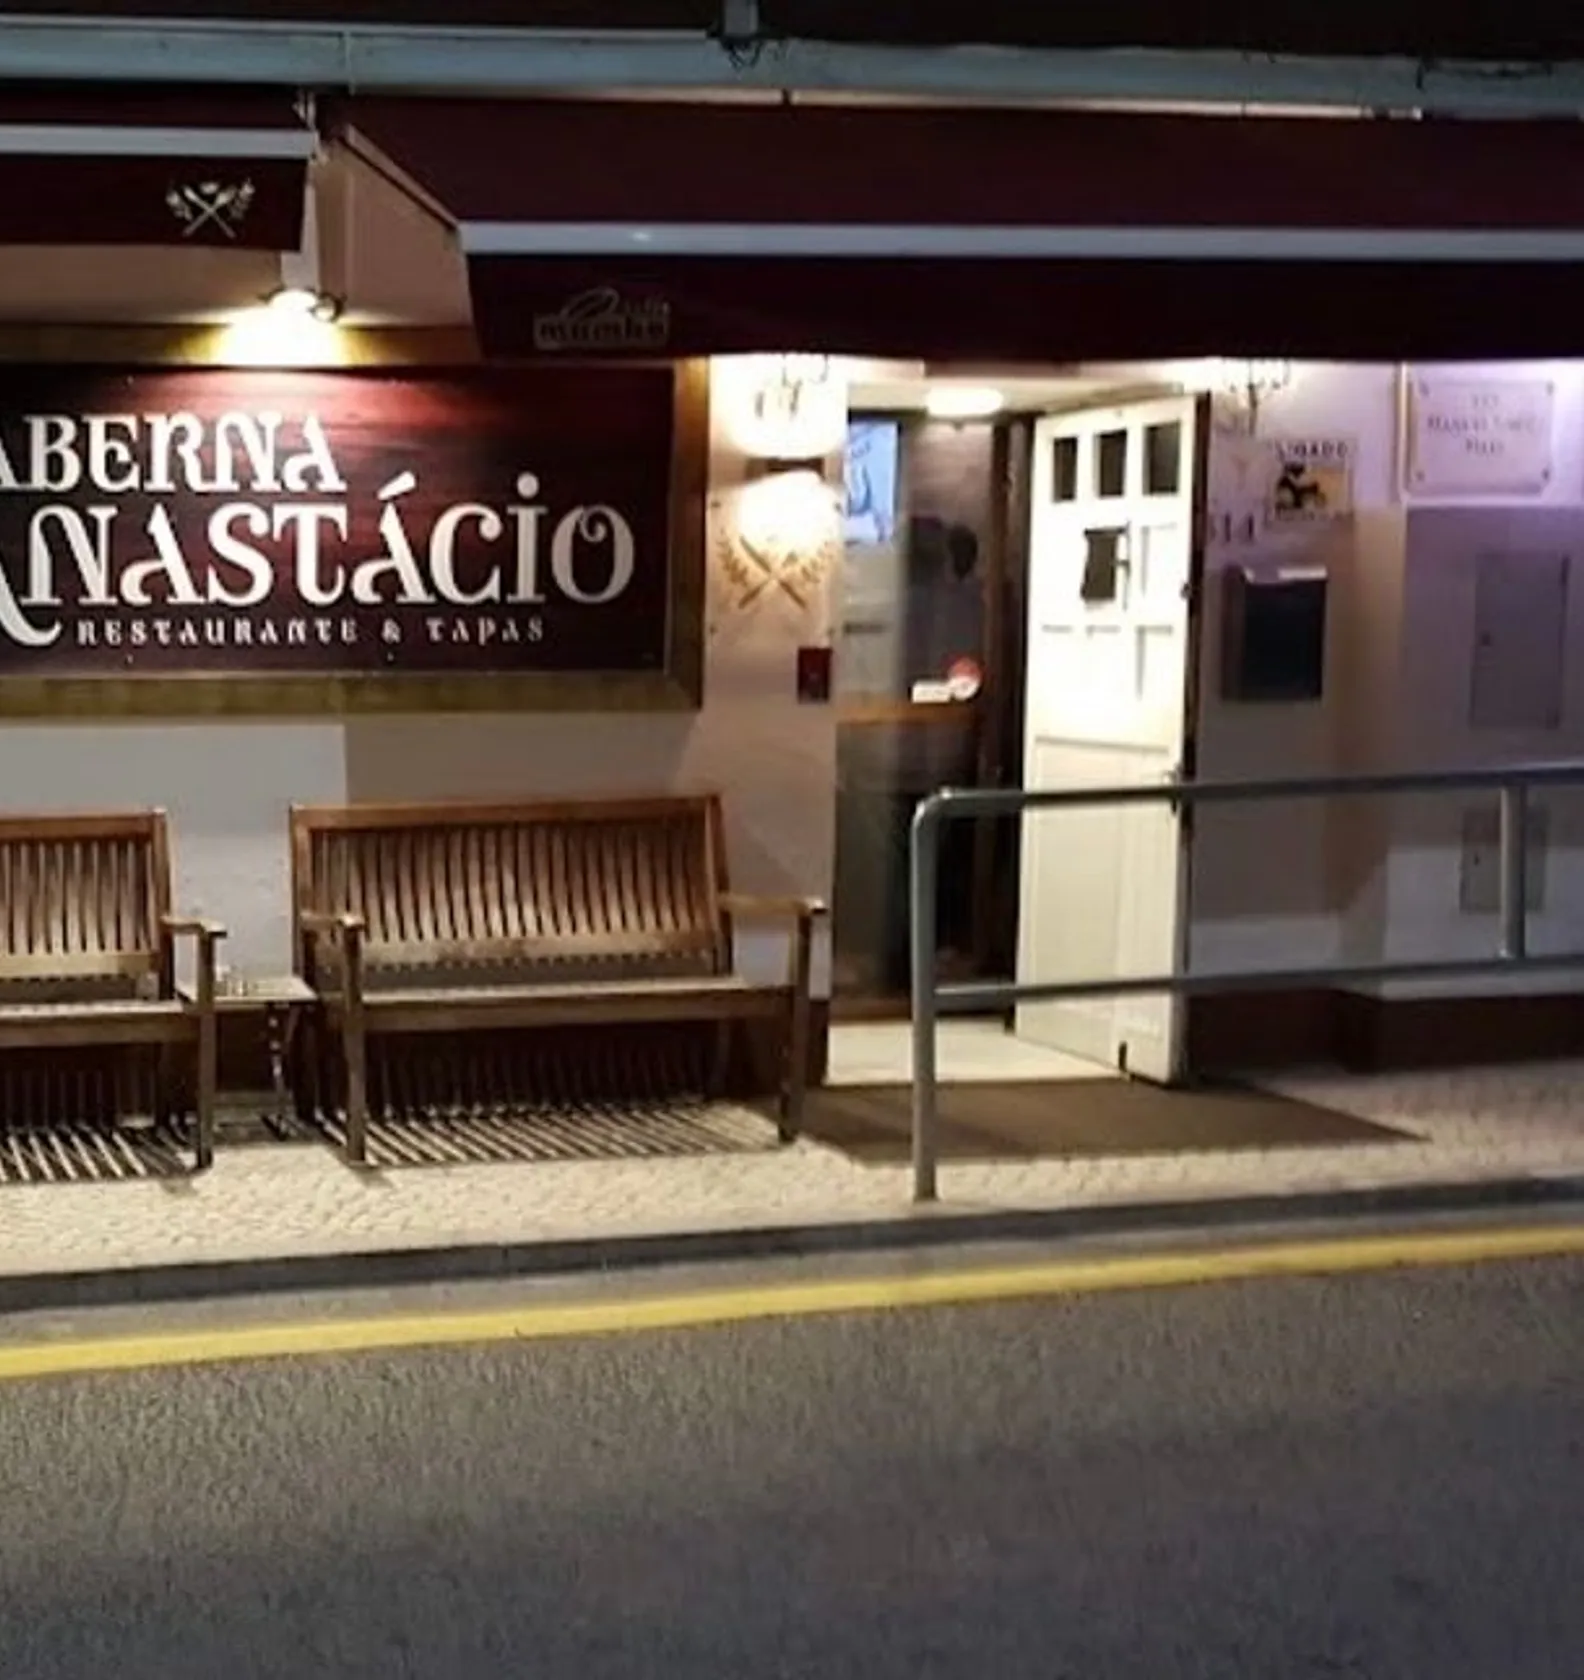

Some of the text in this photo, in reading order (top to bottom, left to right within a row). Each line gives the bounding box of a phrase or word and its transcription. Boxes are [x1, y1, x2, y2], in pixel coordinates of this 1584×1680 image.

[77, 616, 544, 646] RESTAURANTE & TAPAS
